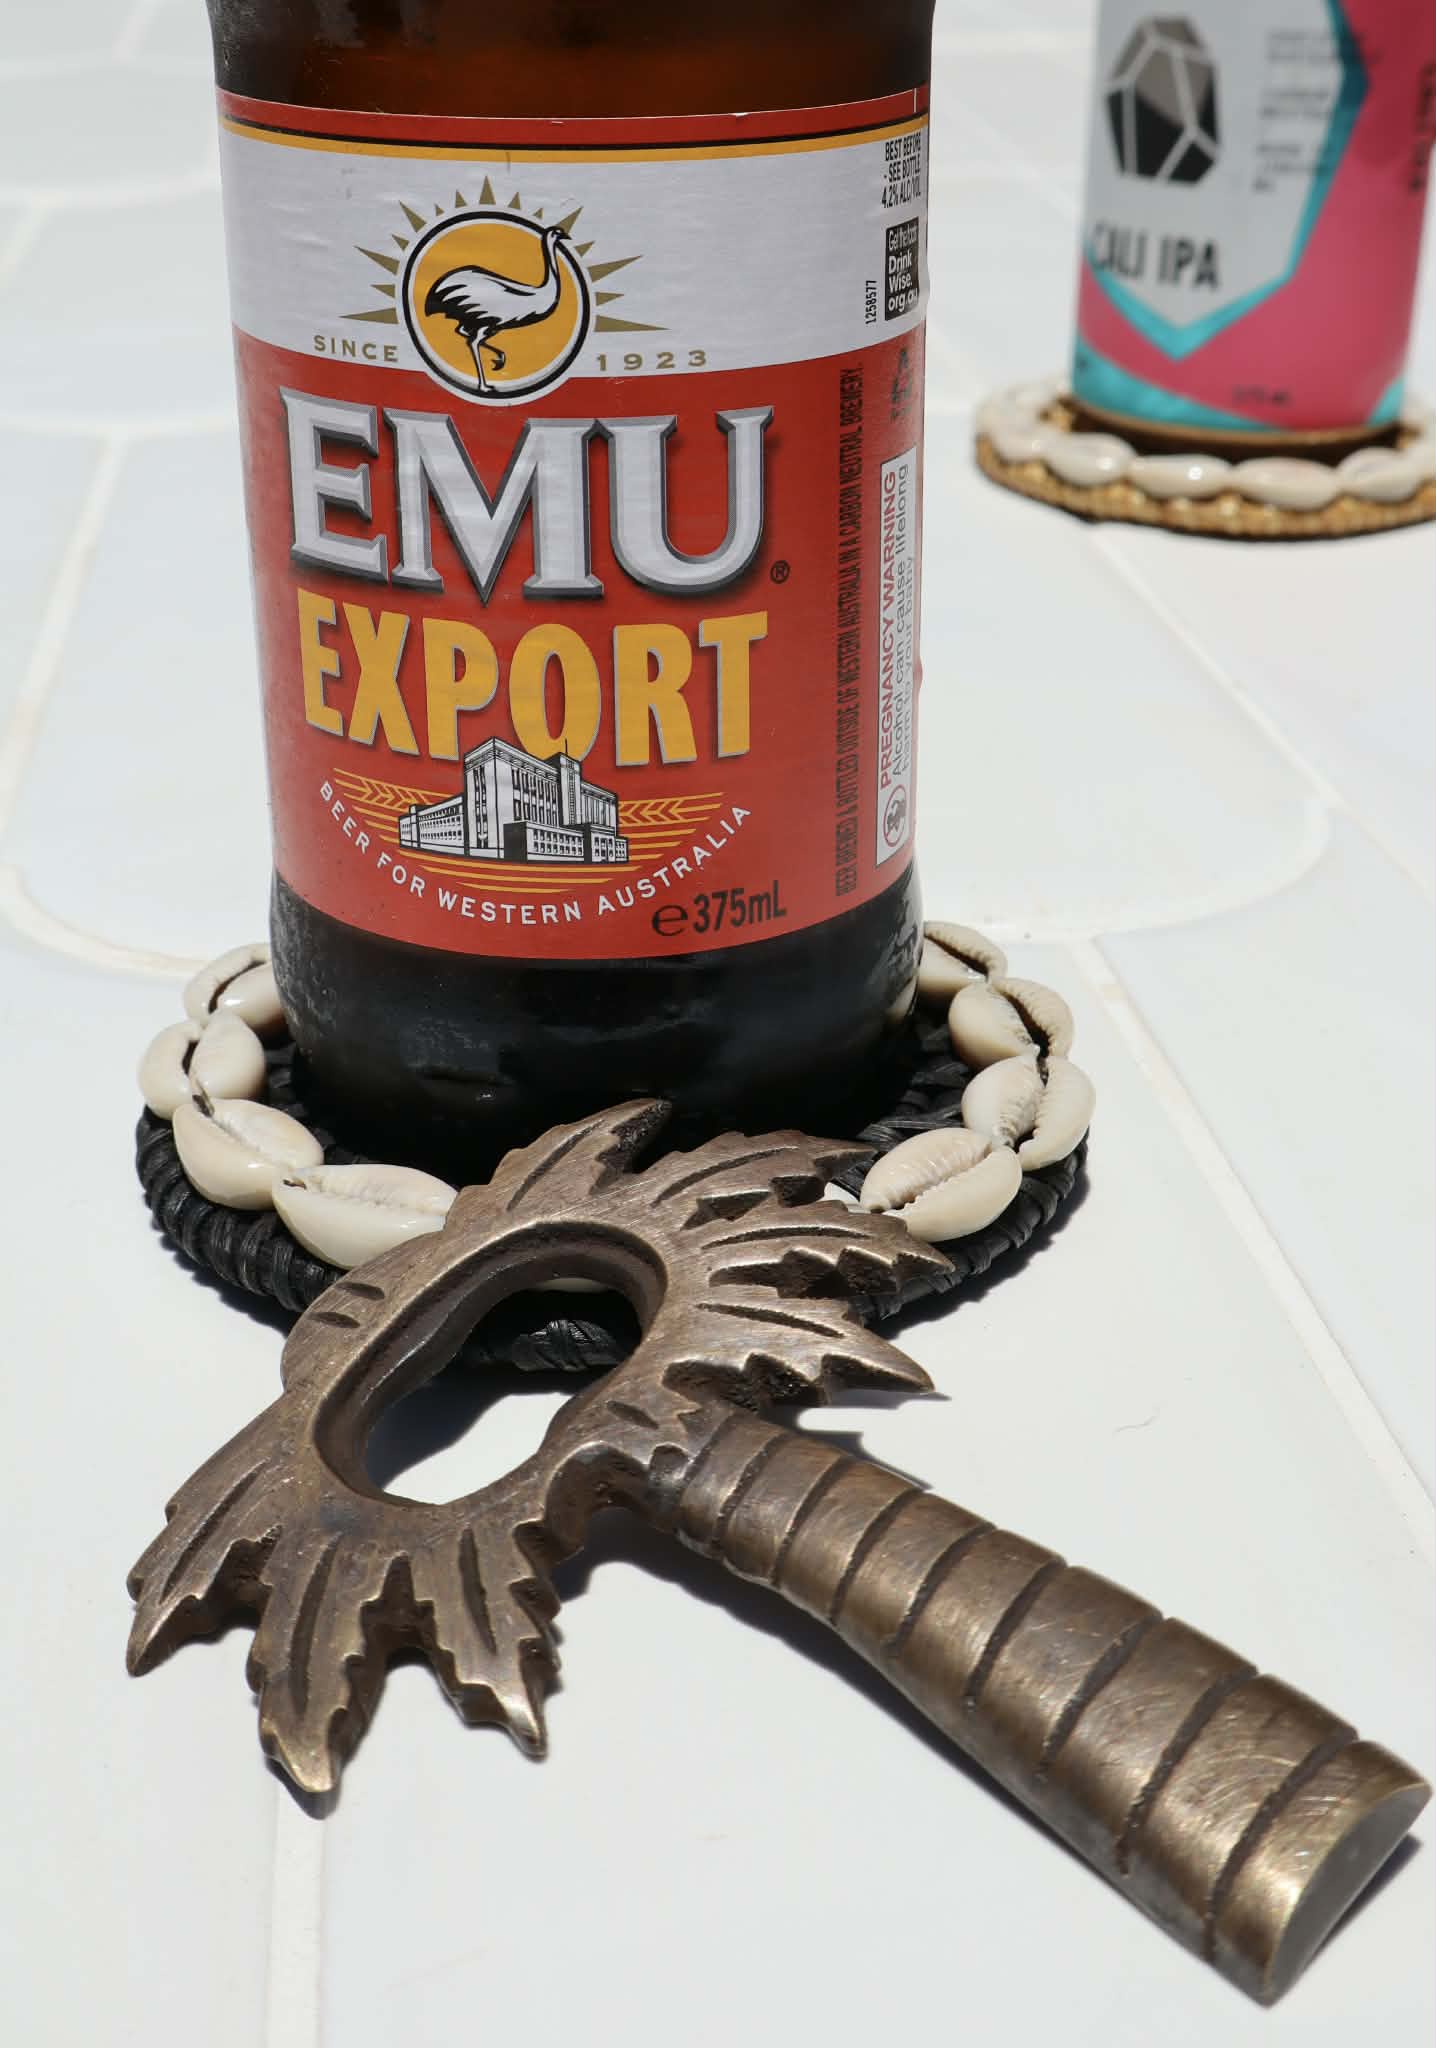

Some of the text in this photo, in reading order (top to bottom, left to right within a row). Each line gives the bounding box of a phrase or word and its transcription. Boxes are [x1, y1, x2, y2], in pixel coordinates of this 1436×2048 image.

[885, 139, 902, 161] BEST
[889, 161, 901, 183] SEE
[881, 183, 898, 208] 4.2%
[888, 249, 912, 274] Drink
[888, 272, 913, 293] Wise.
[1159, 235, 1219, 291] IPA
[865, 280, 877, 324] 1258577
[888, 287, 918, 312] org.au
[313, 334, 398, 363] SINCE
[597, 350, 708, 371] 1923
[839, 426, 862, 485] NEUTRAL
[279, 386, 775, 607] EMU
[839, 485, 861, 537] CARBON
[839, 536, 861, 547] A
[839, 547, 861, 565] IN
[838, 563, 861, 629] AUSTRALIA
[881, 472, 896, 790] PREGNANCY WARNING
[893, 464, 908, 776] Alcohol can cause lifelong
[296, 587, 768, 766] EXPORT
[837, 628, 860, 688] WESTERN
[837, 687, 859, 704] OF
[837, 702, 859, 755] OUTSIDE
[836, 754, 858, 808] BOTTLED
[836, 804, 858, 817] &
[320, 781, 751, 926] BEER FOR WESTERN AUSTRALIA
[836, 816, 858, 866] BREWED
[836, 861, 857, 897] BEER
[693, 879, 788, 933] 375mL
